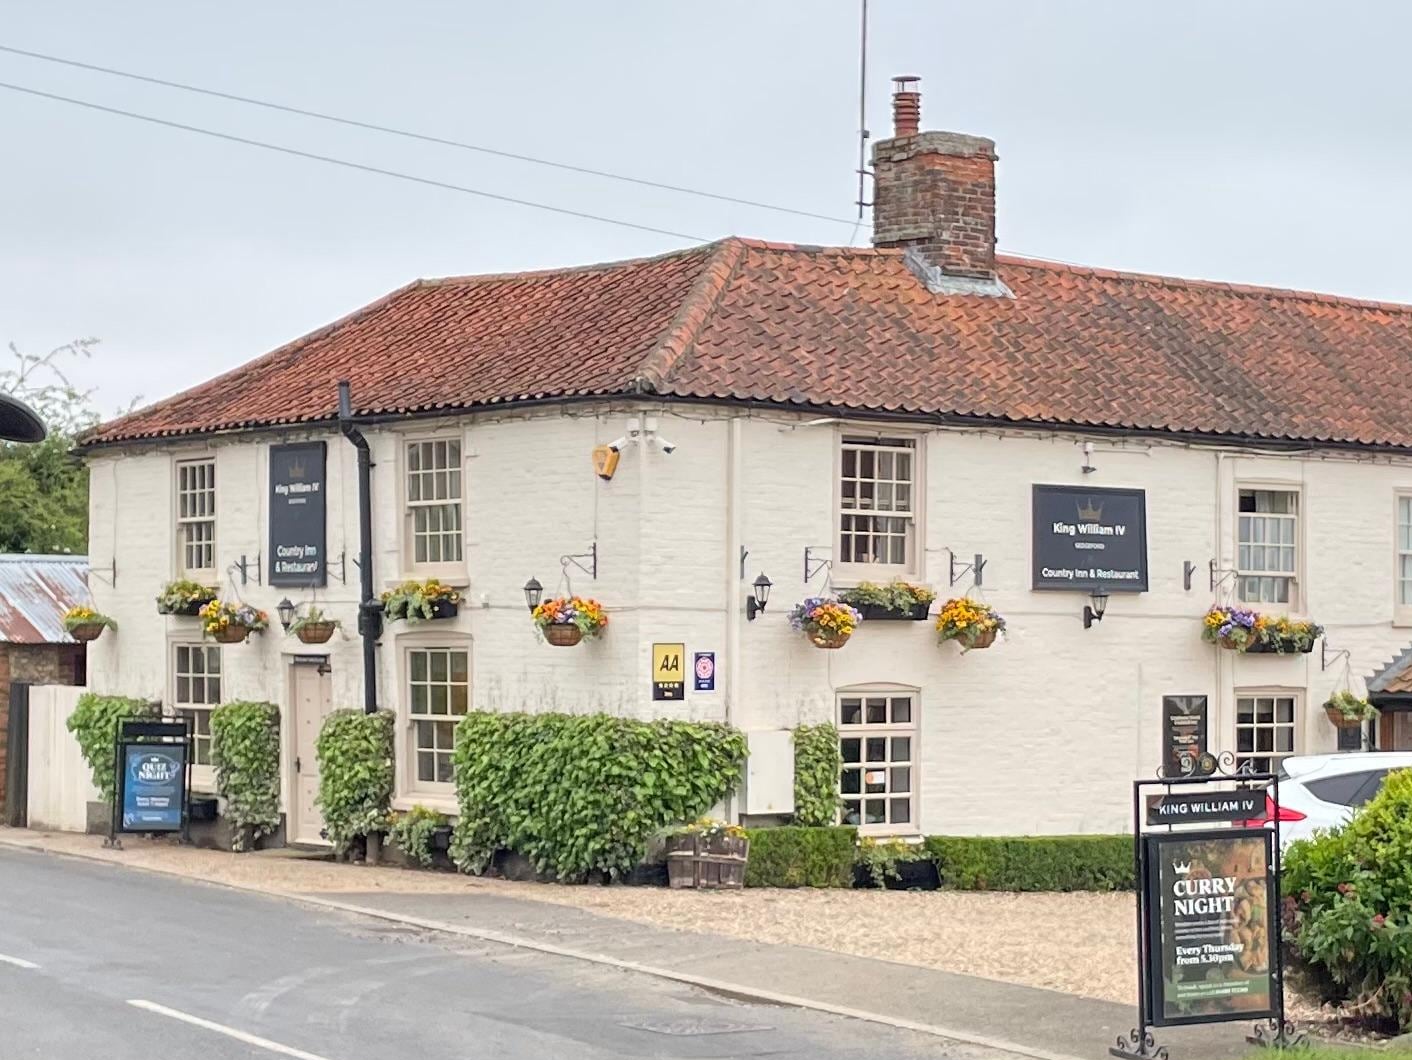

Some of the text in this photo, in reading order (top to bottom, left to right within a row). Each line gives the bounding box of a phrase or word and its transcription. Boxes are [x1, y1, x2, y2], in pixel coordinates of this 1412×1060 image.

[1053, 522, 1125, 536] King William IV
[276, 545, 317, 559] Country Inn
[281, 561, 318, 573] Restaurant
[1042, 568, 1139, 579] Country Inn & Restaurant
[660, 655, 679, 671] AA
[142, 763, 167, 771] QUIZ
[138, 771, 169, 780] NIGHT
[1160, 800, 1254, 815] KING WILLIAM IV
[1173, 877, 1237, 897] CURRY
[1174, 896, 1235, 916] NIGHT
[1176, 943, 1245, 956] Every Thursday
[1176, 956, 1200, 965] from
